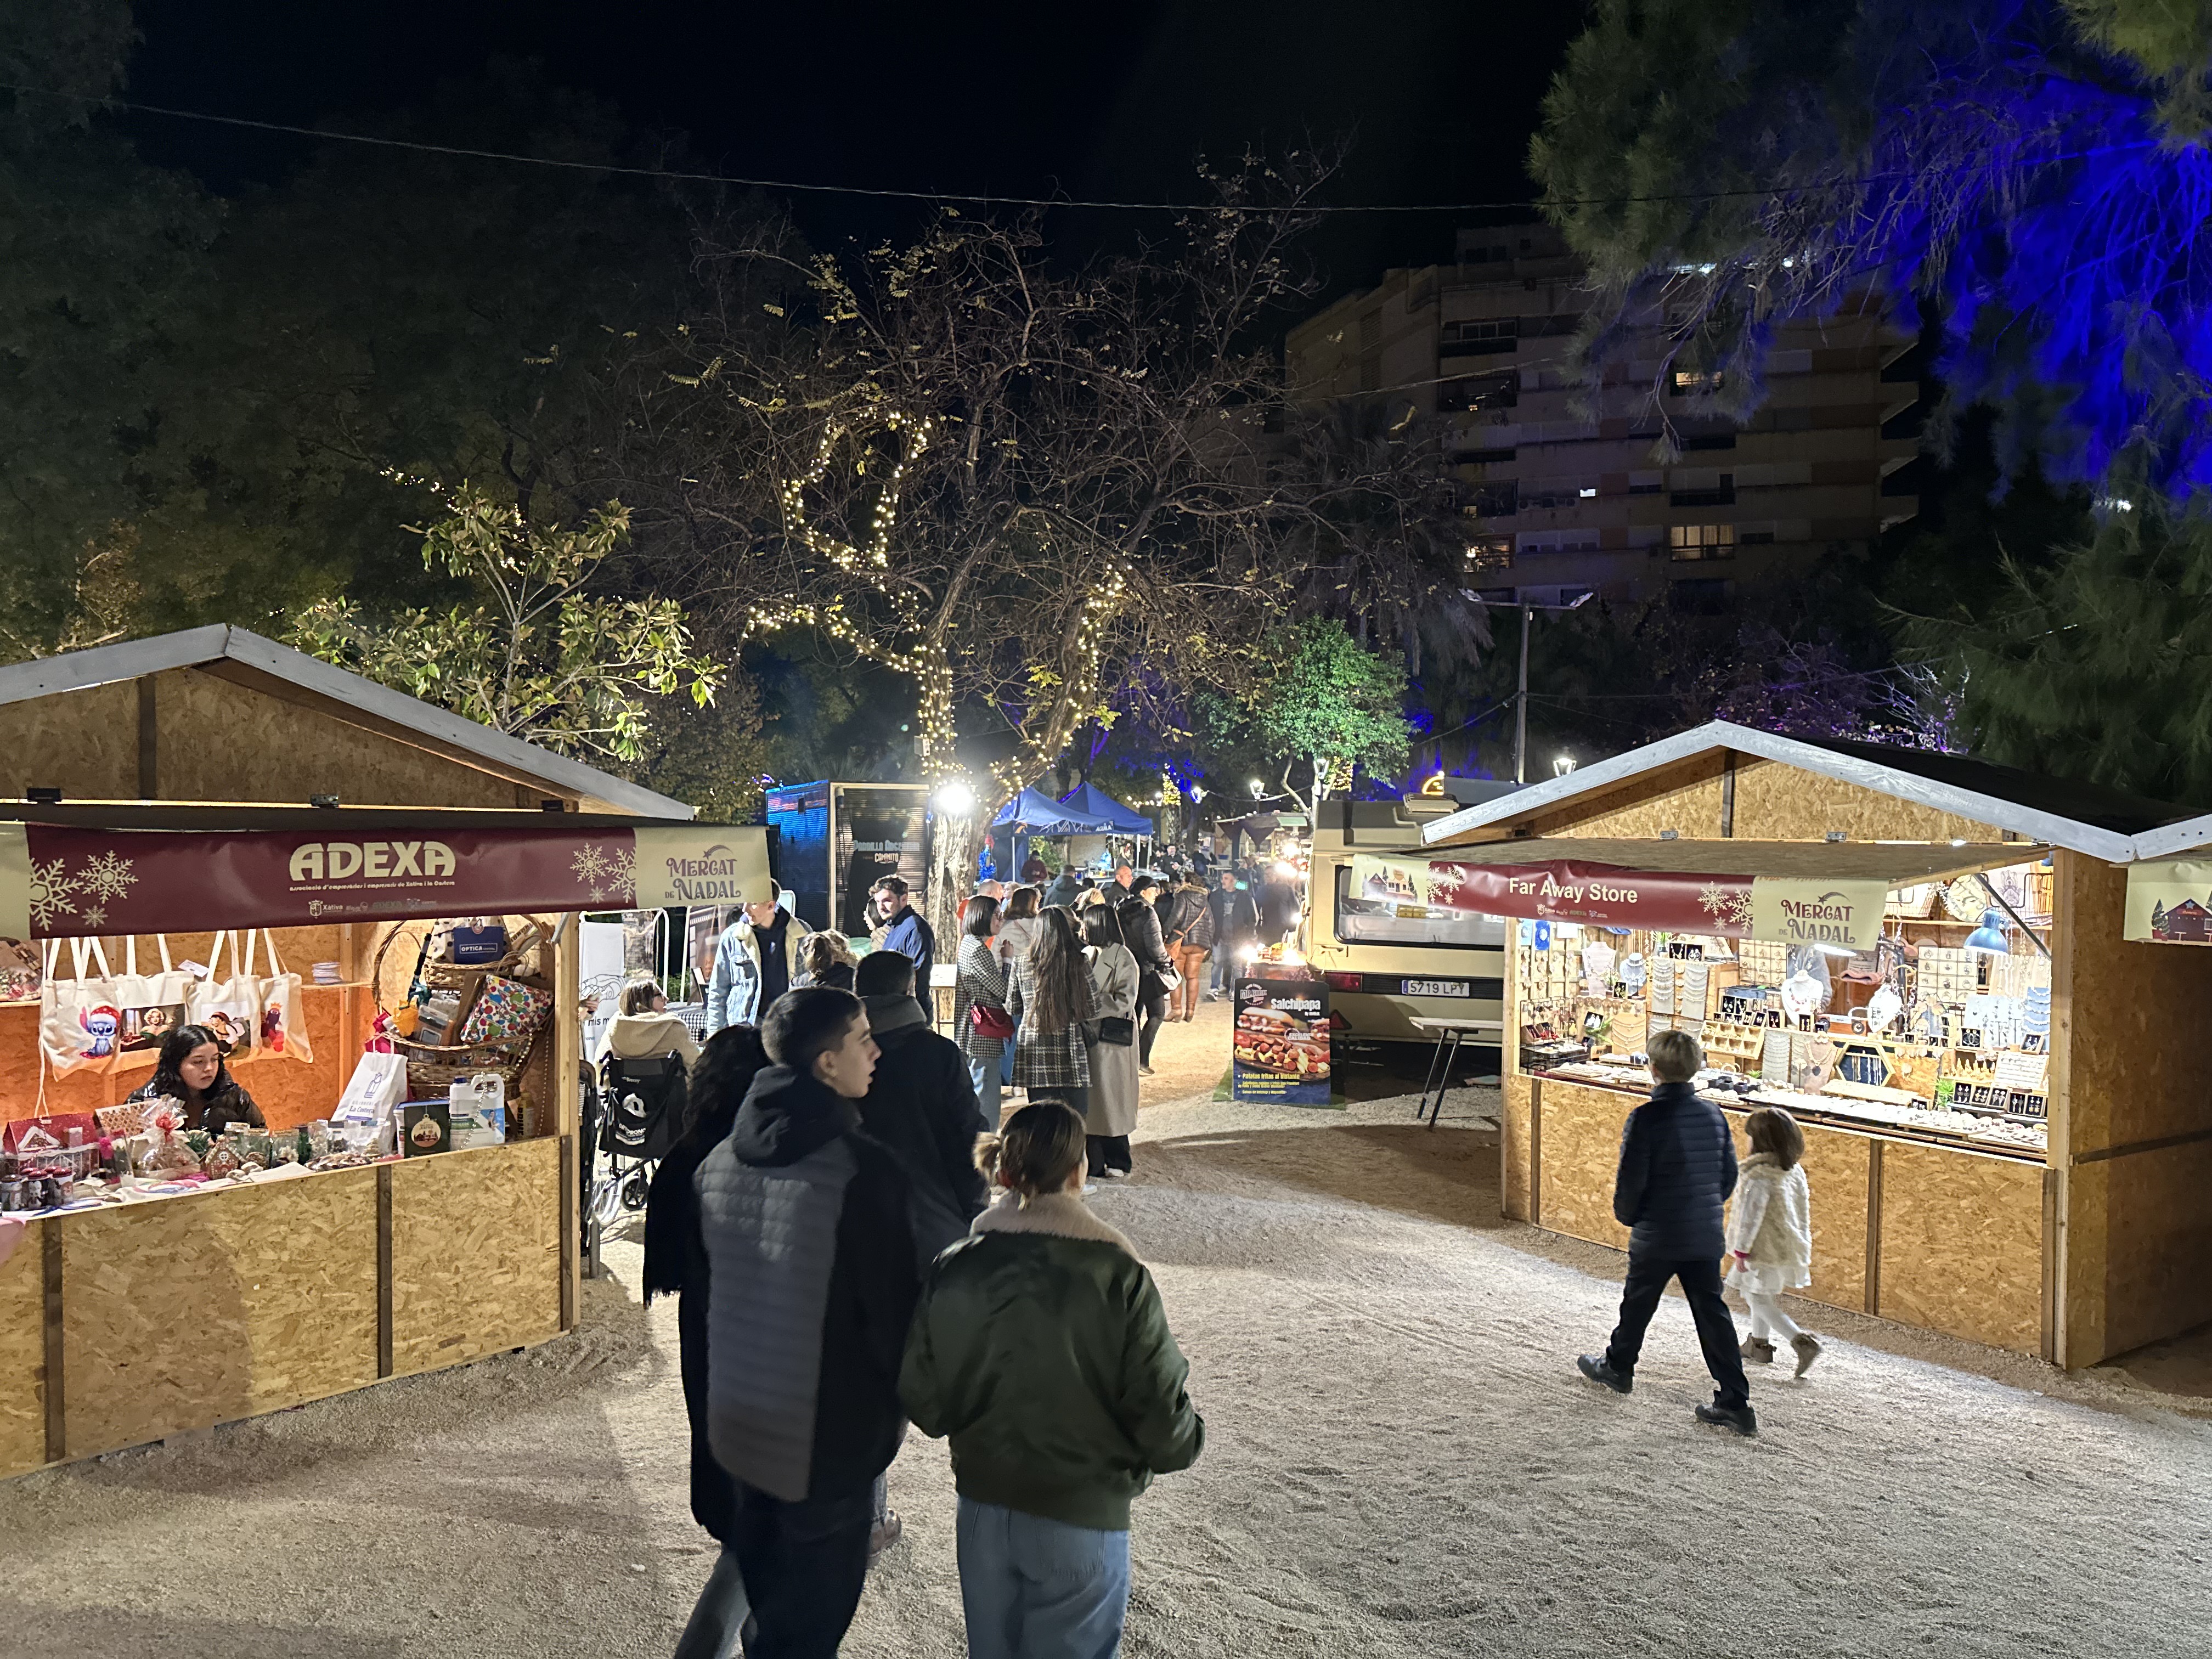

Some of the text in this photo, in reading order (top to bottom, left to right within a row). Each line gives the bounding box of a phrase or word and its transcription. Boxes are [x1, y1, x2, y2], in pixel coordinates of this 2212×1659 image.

[289, 841, 456, 881] ADEXA
[666, 857, 737, 877] MERCAT
[673, 878, 741, 900] NADAL
[1509, 878, 1638, 904] Far Away Store
[1781, 900, 1854, 922] MERCAT
[1787, 918, 1856, 944] NADAL
[1410, 983, 1465, 995] 5719 LPY
[1271, 998, 1321, 1011] Salchipapa
[588, 1016, 601, 1026] mis
